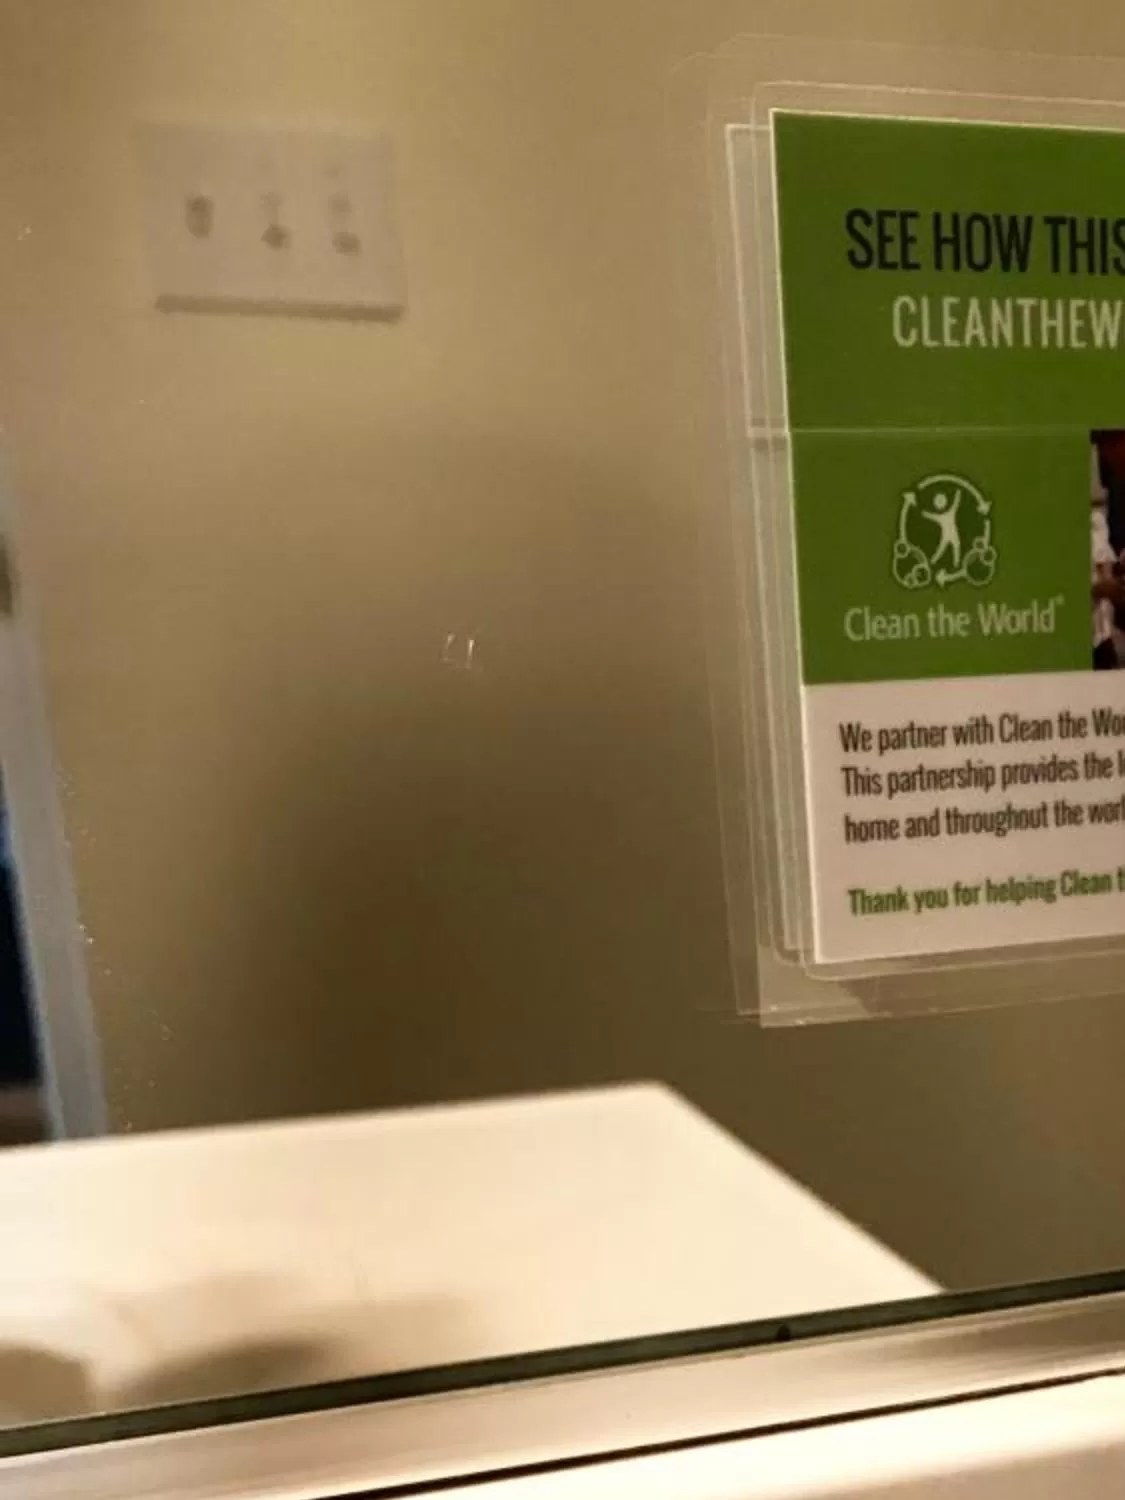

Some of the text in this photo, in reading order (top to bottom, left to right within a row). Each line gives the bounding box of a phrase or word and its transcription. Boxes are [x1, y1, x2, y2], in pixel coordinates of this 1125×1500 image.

[845, 209, 919, 271] SEE
[934, 212, 1034, 274] HOW
[844, 600, 1055, 641] Clean the World
[839, 722, 872, 752] We
[878, 721, 947, 755] partner
[952, 713, 994, 746] with
[999, 712, 1053, 743] Clean
[1058, 711, 1087, 738] the
[841, 766, 883, 797] This
[888, 759, 995, 799] partnership
[1001, 753, 1080, 791] provides
[1084, 750, 1112, 780] the
[844, 813, 899, 842] home
[905, 808, 940, 838] and
[946, 801, 1049, 838] throughout
[1054, 800, 1083, 826] the
[848, 887, 910, 916] Thank
[914, 888, 948, 914] you
[953, 880, 981, 907] for
[986, 876, 1056, 905] helping
[1060, 869, 1112, 896] Clean
